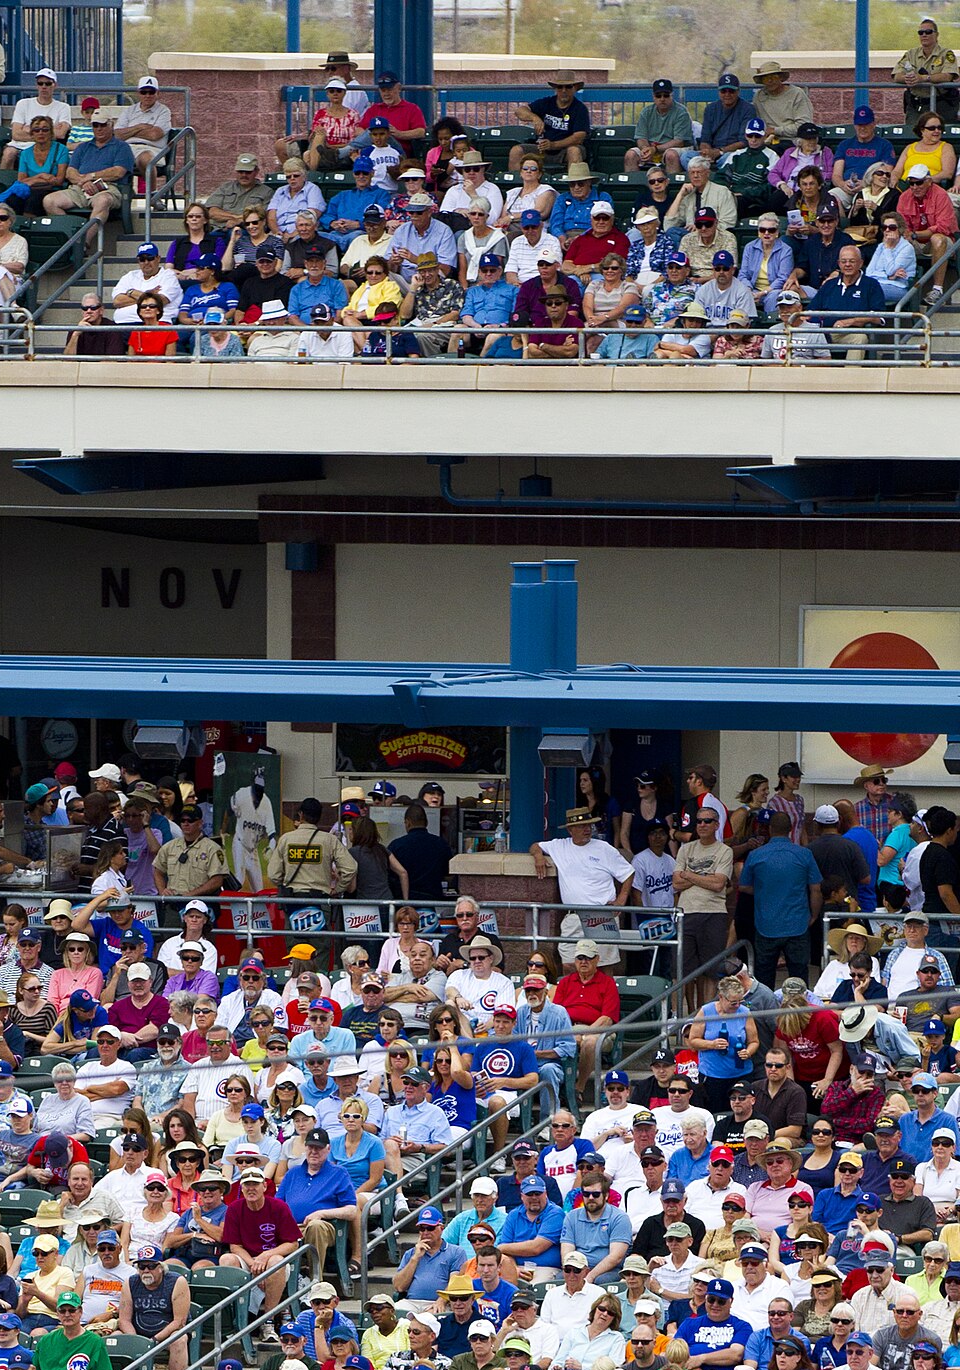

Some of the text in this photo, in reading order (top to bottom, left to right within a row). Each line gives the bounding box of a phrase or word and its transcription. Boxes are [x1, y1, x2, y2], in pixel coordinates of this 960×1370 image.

[637, 736, 652, 745] EXIT
[396, 746, 454, 760] SOFT PRETZELS
[28, 915, 42, 924] TIME
[345, 914, 379, 929] Miller
[583, 915, 614, 928] Miller
[256, 920, 270, 929] TIME
[365, 924, 381, 932] TIME
[481, 923, 497, 932] TIME
[603, 924, 618, 932] TIME
[657, 1132, 684, 1147] Doye
[133, 1297, 168, 1310] CUBS
